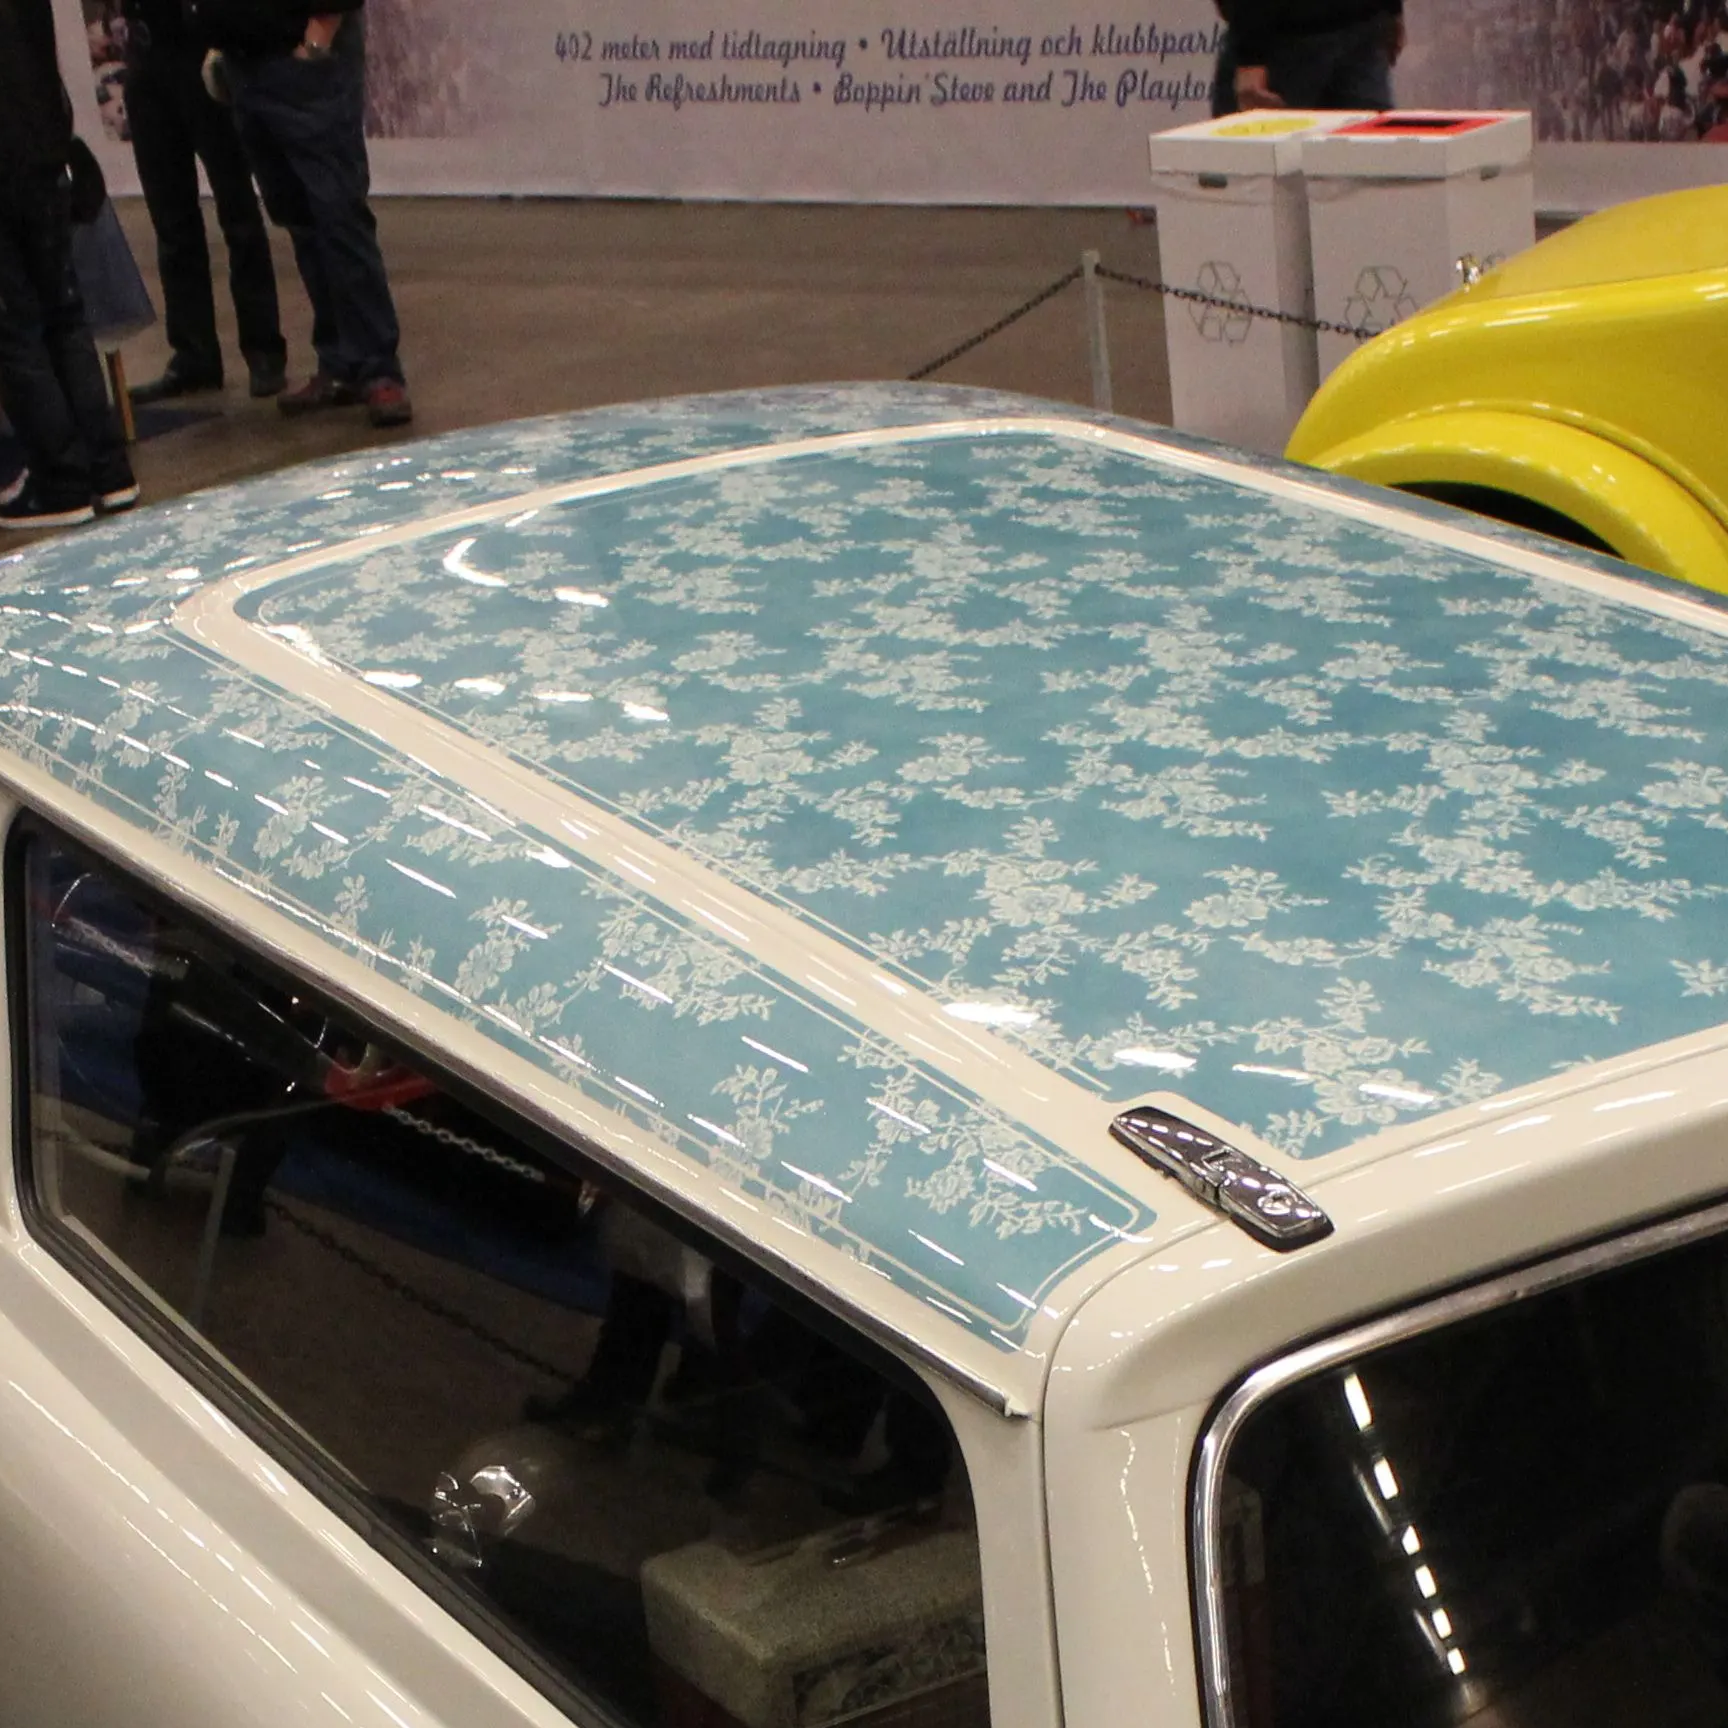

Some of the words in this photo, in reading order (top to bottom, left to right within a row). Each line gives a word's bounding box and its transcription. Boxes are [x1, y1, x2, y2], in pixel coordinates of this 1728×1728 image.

[556, 30, 593, 62] 402
[601, 34, 660, 60] meter
[668, 30, 715, 60] med
[720, 29, 846, 69] tidtagning
[881, 26, 1031, 66] Utställning
[1039, 25, 1082, 57] och
[1090, 21, 1223, 64] klubbpark
[599, 72, 638, 107] The
[645, 72, 800, 112] Refreshments
[930, 69, 996, 106] Steve
[1003, 70, 1054, 101] and
[1061, 68, 1108, 107] The
[1116, 67, 1216, 110] Playto
